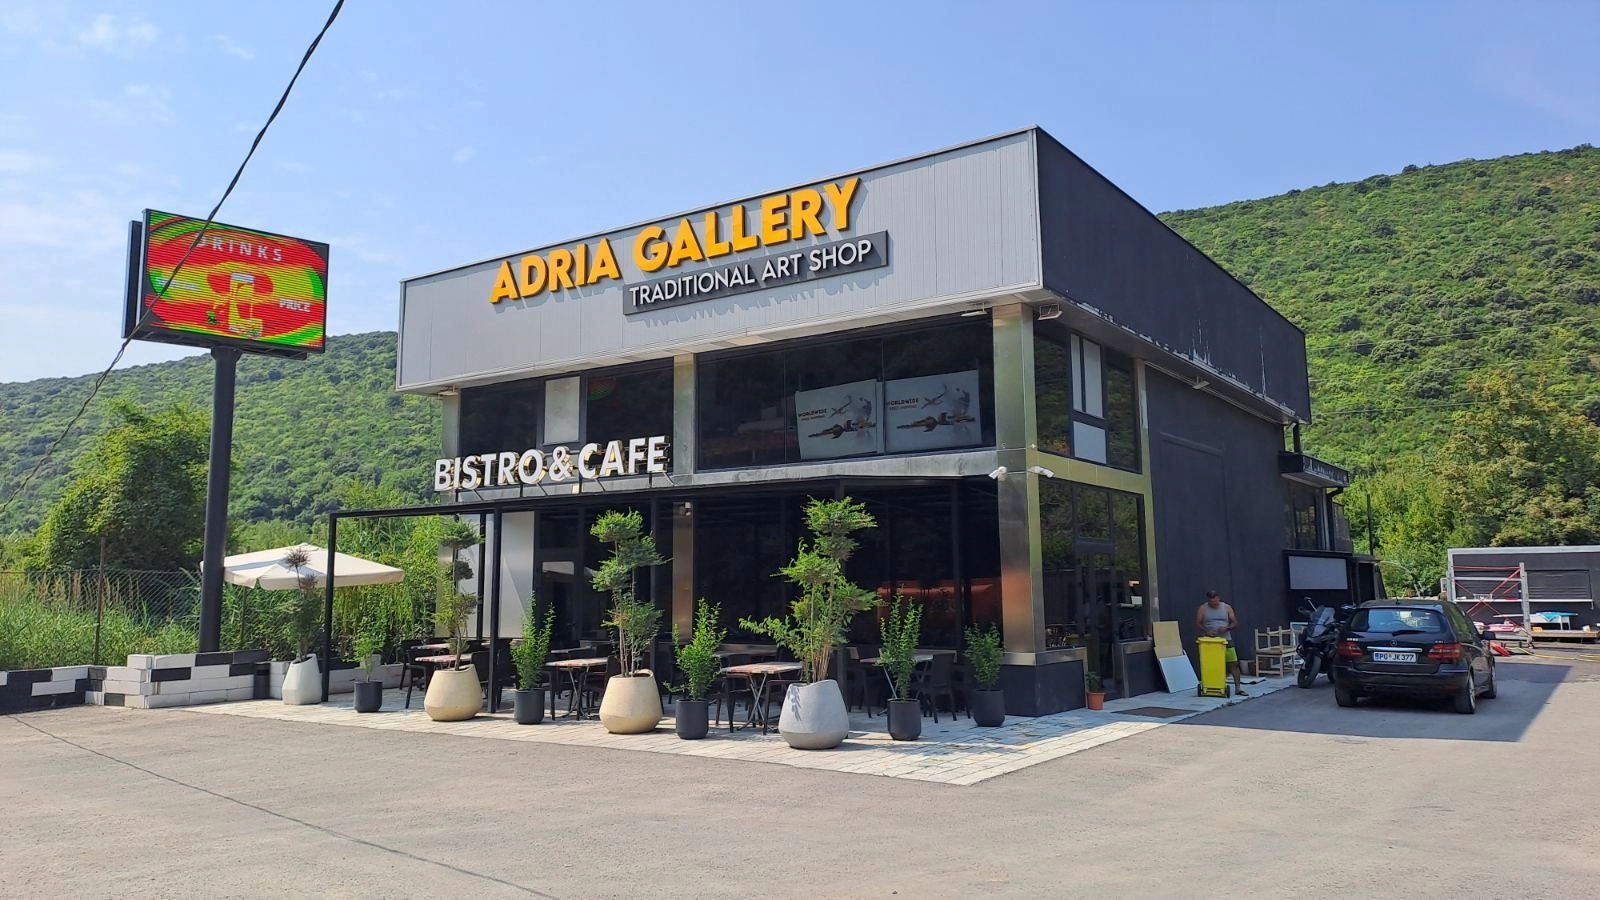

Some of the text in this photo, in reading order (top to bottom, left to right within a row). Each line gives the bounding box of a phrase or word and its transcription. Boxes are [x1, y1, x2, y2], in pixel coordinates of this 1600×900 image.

[194, 231, 283, 261] DRINKS
[490, 177, 860, 304] ADRIA GALLERY
[630, 239, 872, 307] TRADITIONAL ART SHOP
